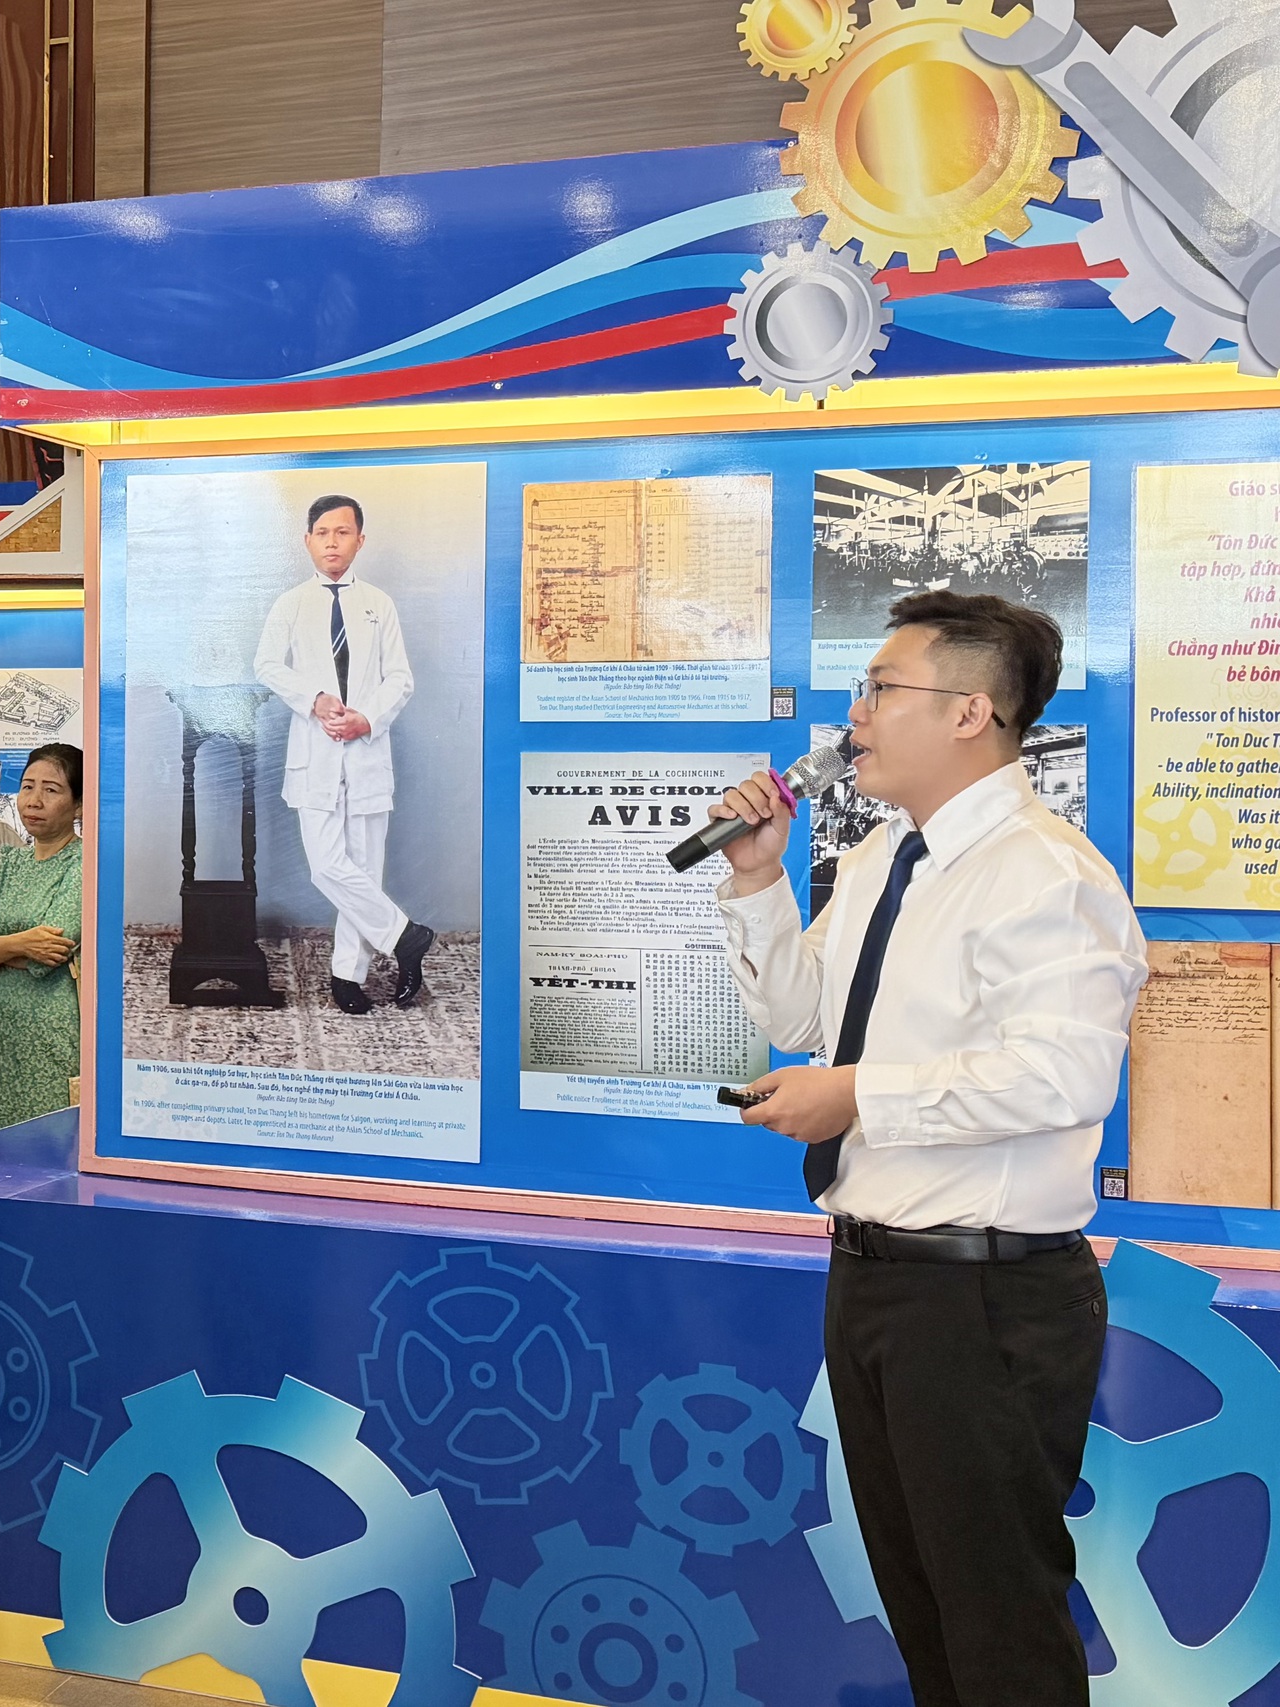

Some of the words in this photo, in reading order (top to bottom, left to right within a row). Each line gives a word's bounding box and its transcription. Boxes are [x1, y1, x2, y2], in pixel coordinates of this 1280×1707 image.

[1229, 480, 1265, 496] Giáo
[1247, 533, 1278, 550] Đức
[1180, 561, 1207, 581] tập
[1211, 561, 1245, 581] hợp,
[1244, 585, 1276, 603] Khả
[1168, 638, 1218, 660] Chẳng
[1221, 639, 1256, 656] như
[1227, 665, 1246, 682] bẻ
[1150, 708, 1216, 722] Professor
[1220, 707, 1235, 722] of
[1216, 733, 1239, 748] Ton
[1243, 733, 1269, 748] Duc
[1166, 758, 1182, 772] be
[1186, 758, 1216, 772] able
[1220, 760, 1234, 772] to
[666, 770, 725, 778] COCHINCHINE
[526, 786, 603, 796] VILLE
[610, 786, 644, 796] DE
[1152, 783, 1202, 801] Ability,
[588, 806, 691, 826] AVIS
[1238, 809, 1266, 824] Was
[1232, 834, 1261, 848] who
[1244, 860, 1278, 874] used
